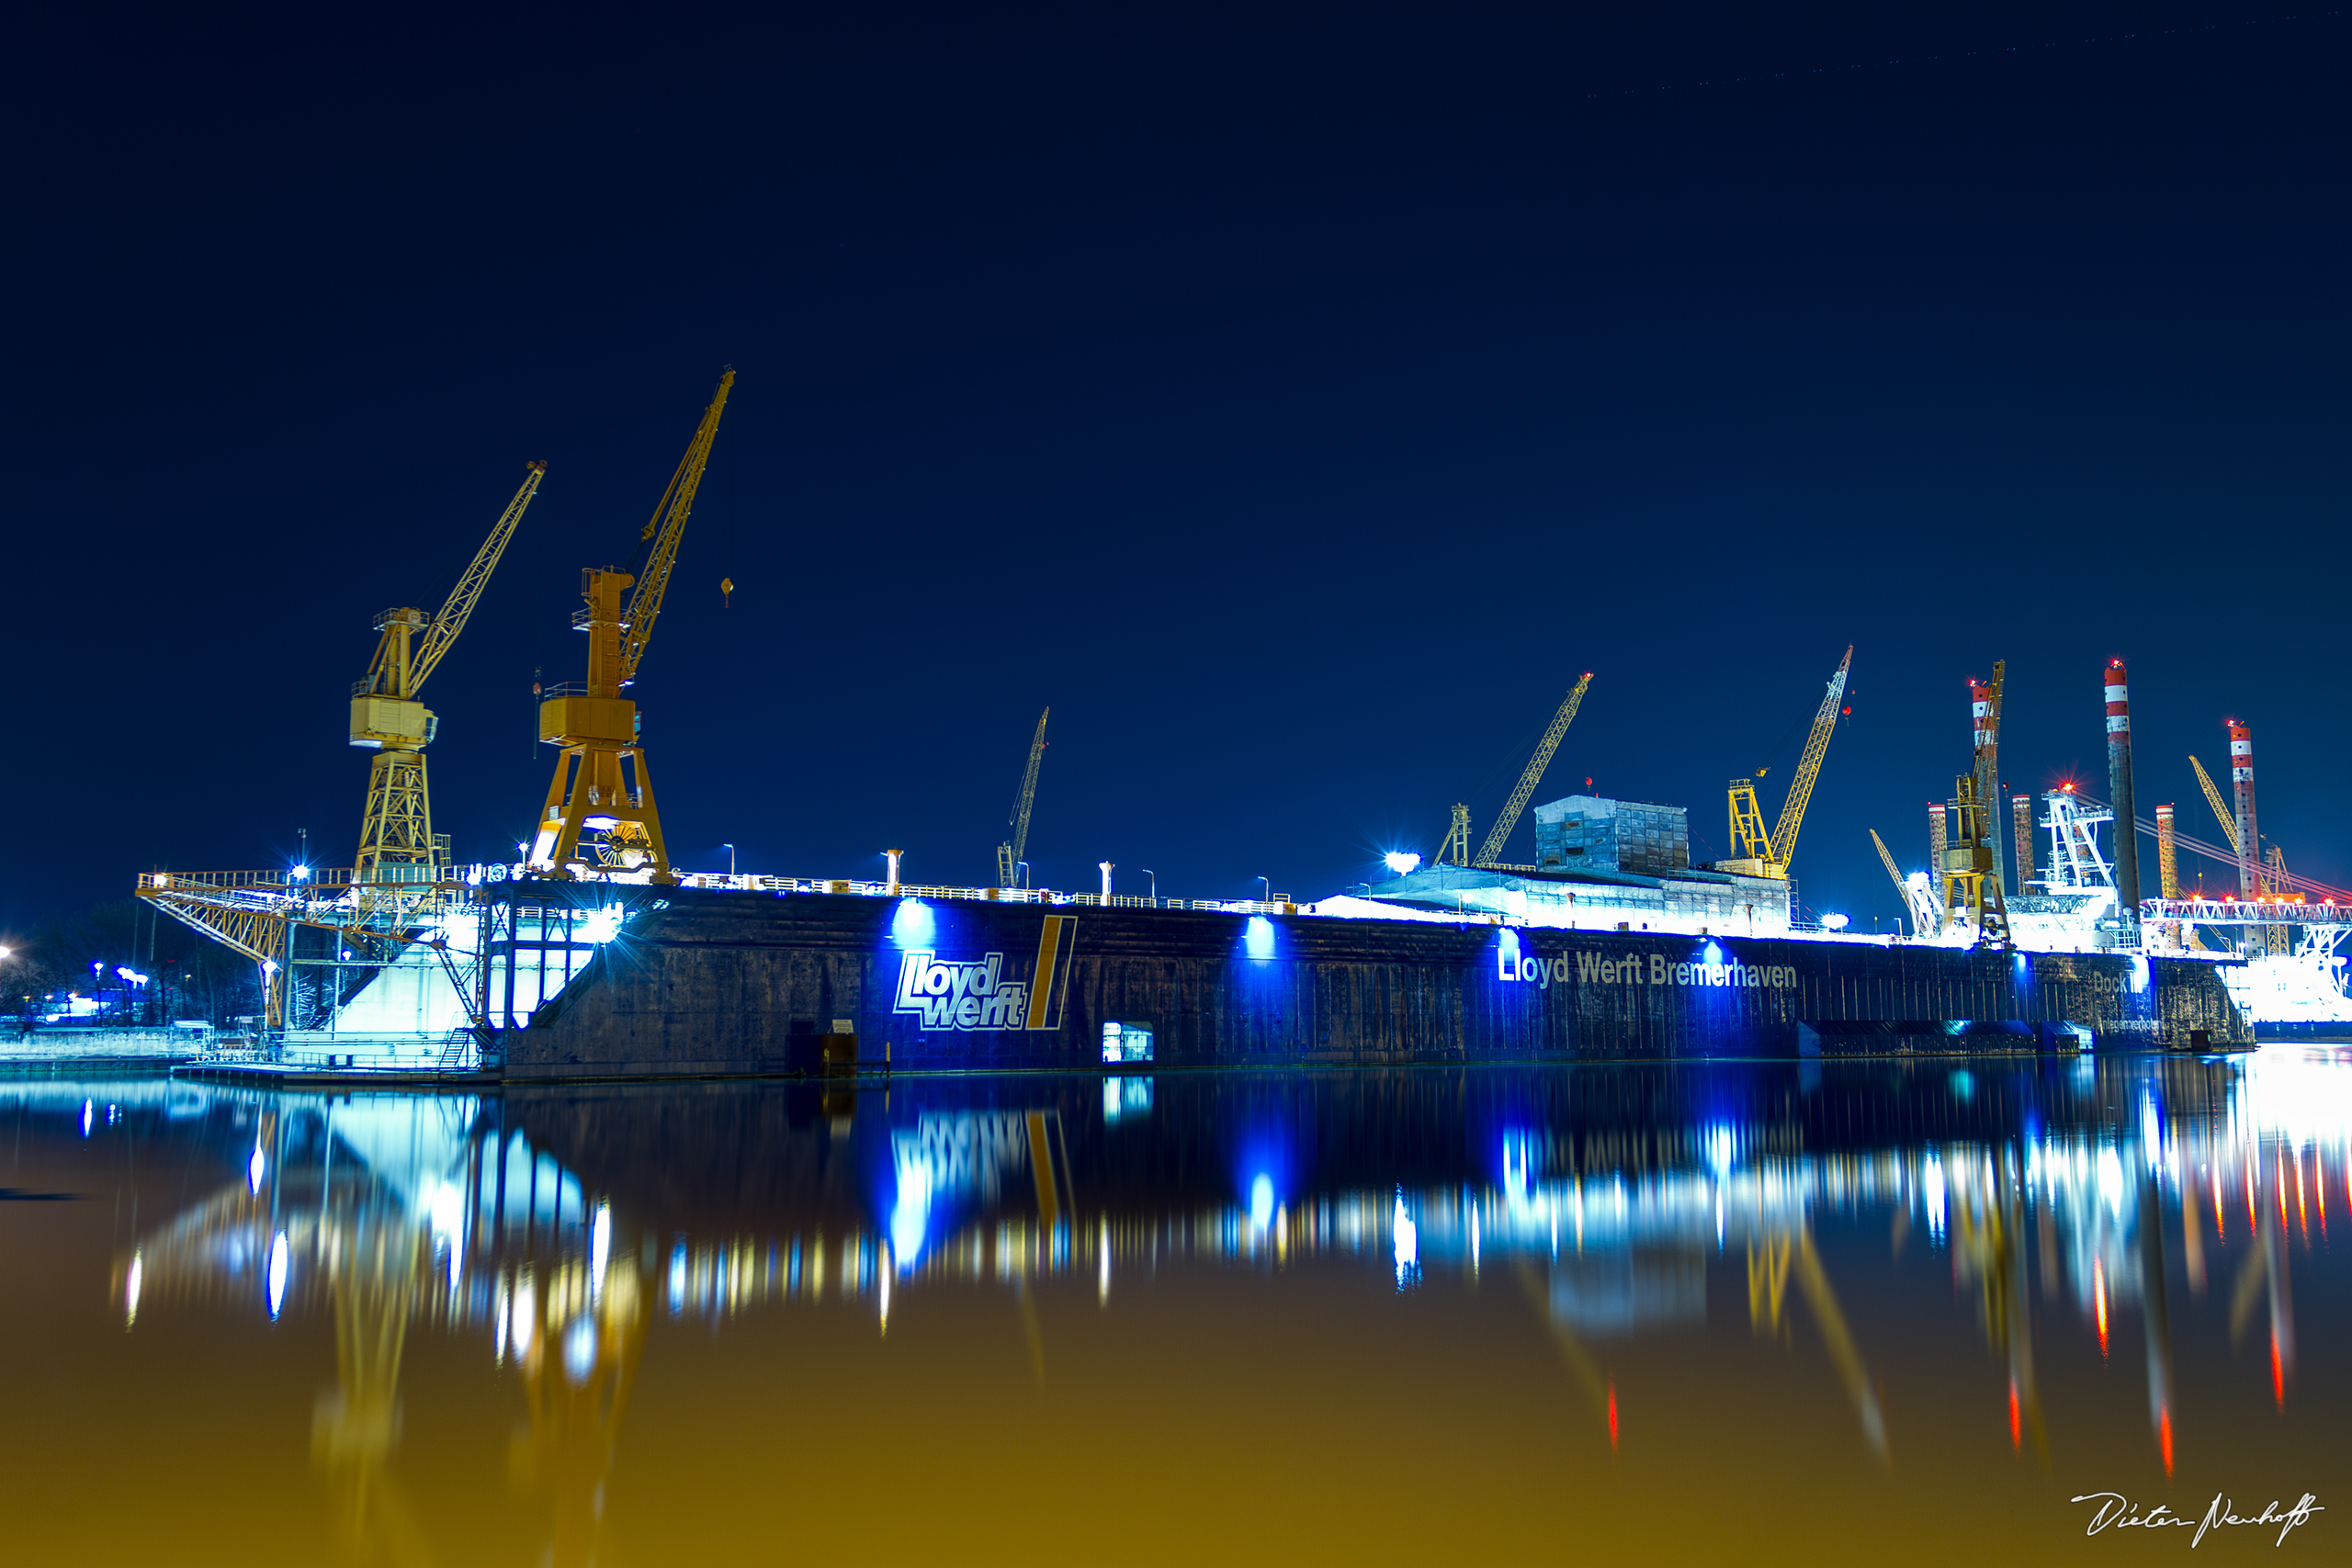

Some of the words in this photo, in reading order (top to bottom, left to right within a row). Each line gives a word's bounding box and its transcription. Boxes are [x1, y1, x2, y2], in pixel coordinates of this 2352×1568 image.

[1498, 948, 1569, 989] Lloyd
[1576, 951, 1643, 984] Werft
[1650, 953, 1797, 987] Bremerhaven
[2094, 971, 2127, 993] Dock
